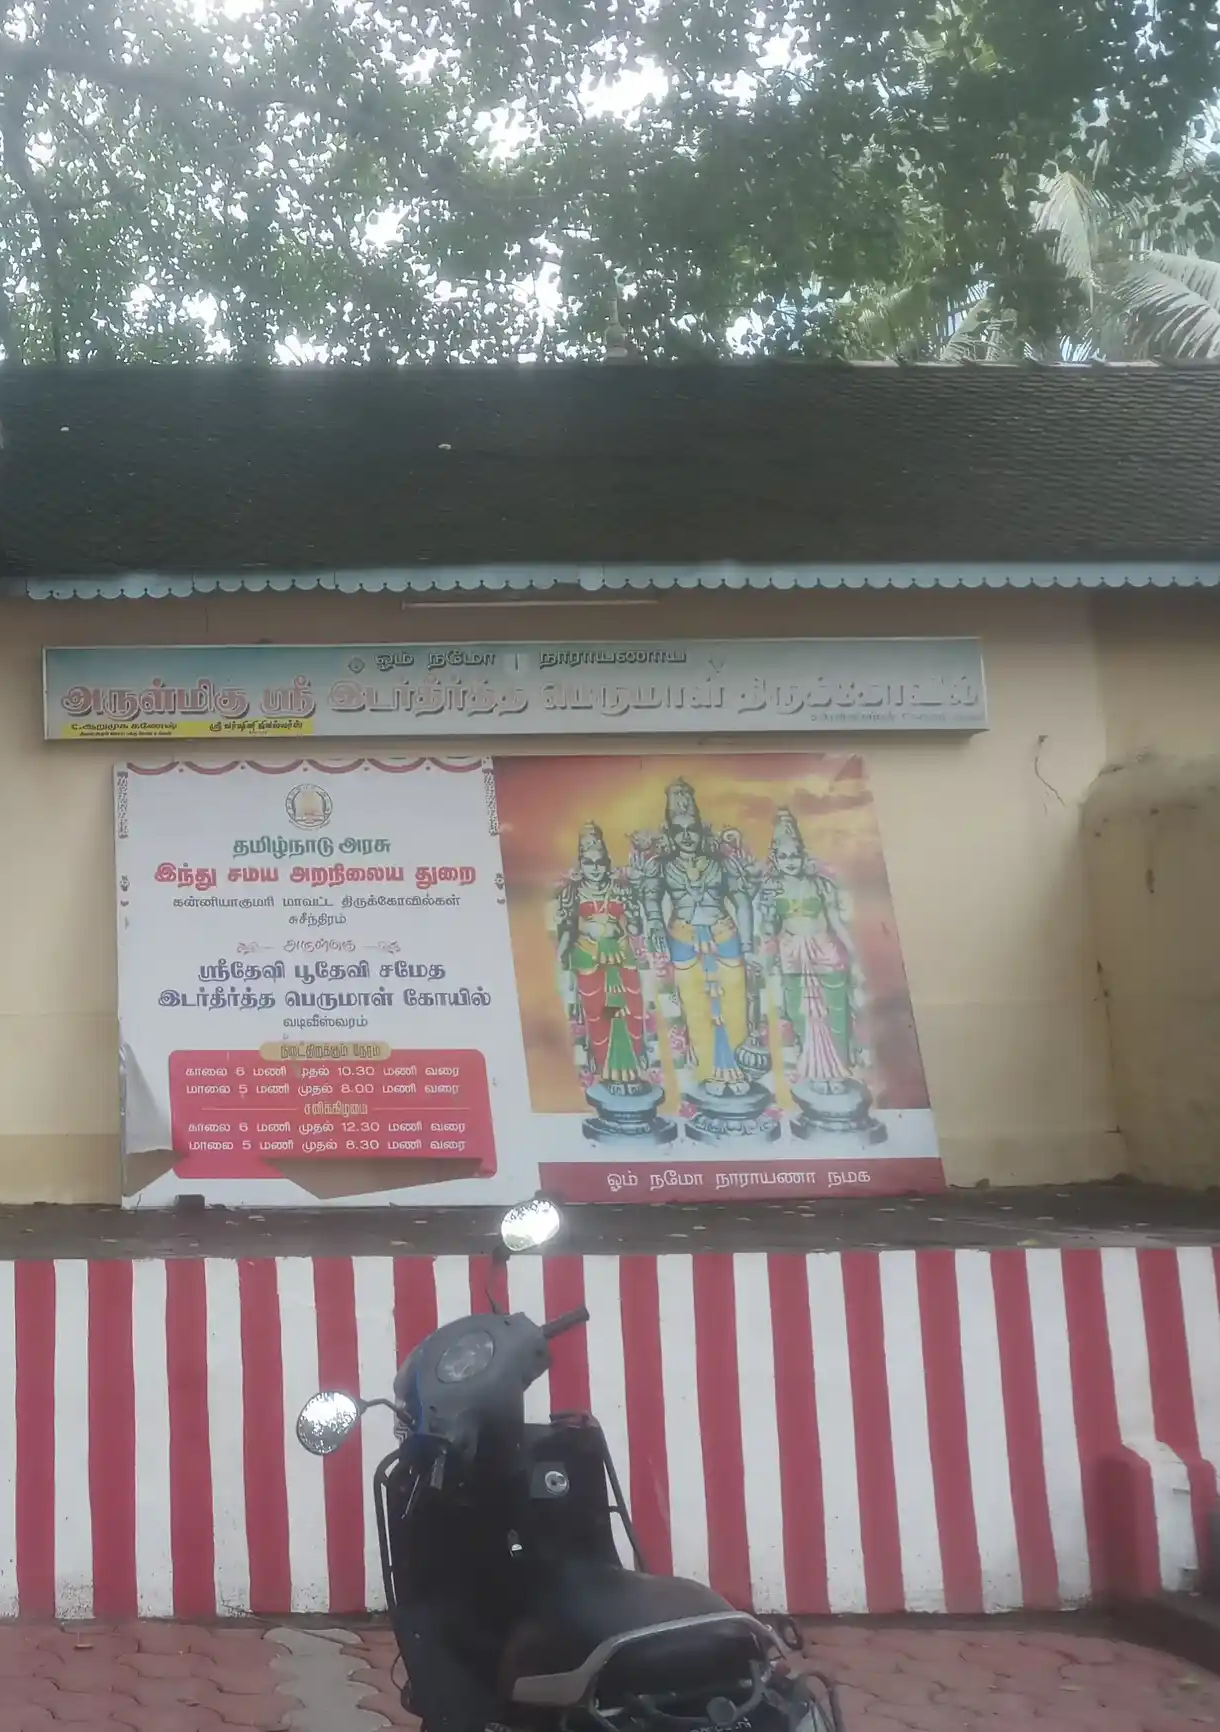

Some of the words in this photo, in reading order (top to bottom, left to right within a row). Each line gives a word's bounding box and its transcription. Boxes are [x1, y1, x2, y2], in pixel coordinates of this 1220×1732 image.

[376, 650, 414, 671] ஓம்
[427, 650, 496, 669] நமோ
[539, 650, 687, 669] நாராயணாய
[61, 675, 250, 720] அருள்மிகு
[327, 675, 529, 718] இடர்தீர்த்த
[233, 836, 335, 859] தமிழ்நாடு
[339, 837, 391, 857] அரசு
[155, 863, 217, 887] இந்து
[228, 865, 279, 883] சமய
[290, 863, 403, 887] அறநிலைய
[415, 864, 476, 888] துறை
[173, 894, 274, 909] கன்னியாகுமரி
[283, 894, 334, 908] மாவட்ட
[341, 893, 461, 909] திருக்கோவில்கள்
[289, 911, 347, 926] சுசீந்திரம்
[198, 959, 285, 983] ஸ்ரீதேவி
[294, 959, 370, 985] பூதேவி
[379, 960, 445, 982] சமேத
[158, 987, 276, 1013] இடர்தீர்த்த
[285, 986, 393, 1012] பெருமாள்
[403, 985, 492, 1008] கோயில்
[283, 1012, 368, 1029] வடிவீஸ்வரம்
[186, 1067, 228, 1077] காலை
[236, 1067, 245, 1076] 6
[253, 1065, 287, 1077] மணி
[338, 1066, 375, 1076] 10.30
[383, 1065, 417, 1076] மணி
[425, 1067, 459, 1077] வரை
[186, 1084, 231, 1094] மாலை
[238, 1084, 248, 1094] 5
[256, 1083, 290, 1094] மணி
[298, 1083, 333, 1096] முதல்
[341, 1084, 374, 1094] 8.00
[382, 1083, 416, 1094] மணி
[425, 1084, 459, 1095] வரை
[188, 1122, 231, 1132] காலை
[239, 1122, 248, 1132] 6
[257, 1121, 291, 1132] மணி
[299, 1120, 334, 1135] முதல்
[342, 1122, 380, 1132] 12.30
[388, 1121, 422, 1132] மணி
[430, 1122, 466, 1133] வரை
[189, 1140, 233, 1150] மாலை
[242, 1140, 251, 1150] 5
[260, 1139, 294, 1150] மணி
[301, 1138, 337, 1153] முதல்
[345, 1140, 379, 1150] 8.30
[387, 1139, 422, 1150] மணி
[430, 1140, 466, 1151] வரை
[607, 1169, 639, 1192] ஓம்
[649, 1169, 704, 1192] நமோ
[715, 1169, 816, 1190] நாராயணா
[827, 1170, 872, 1188] நமக
